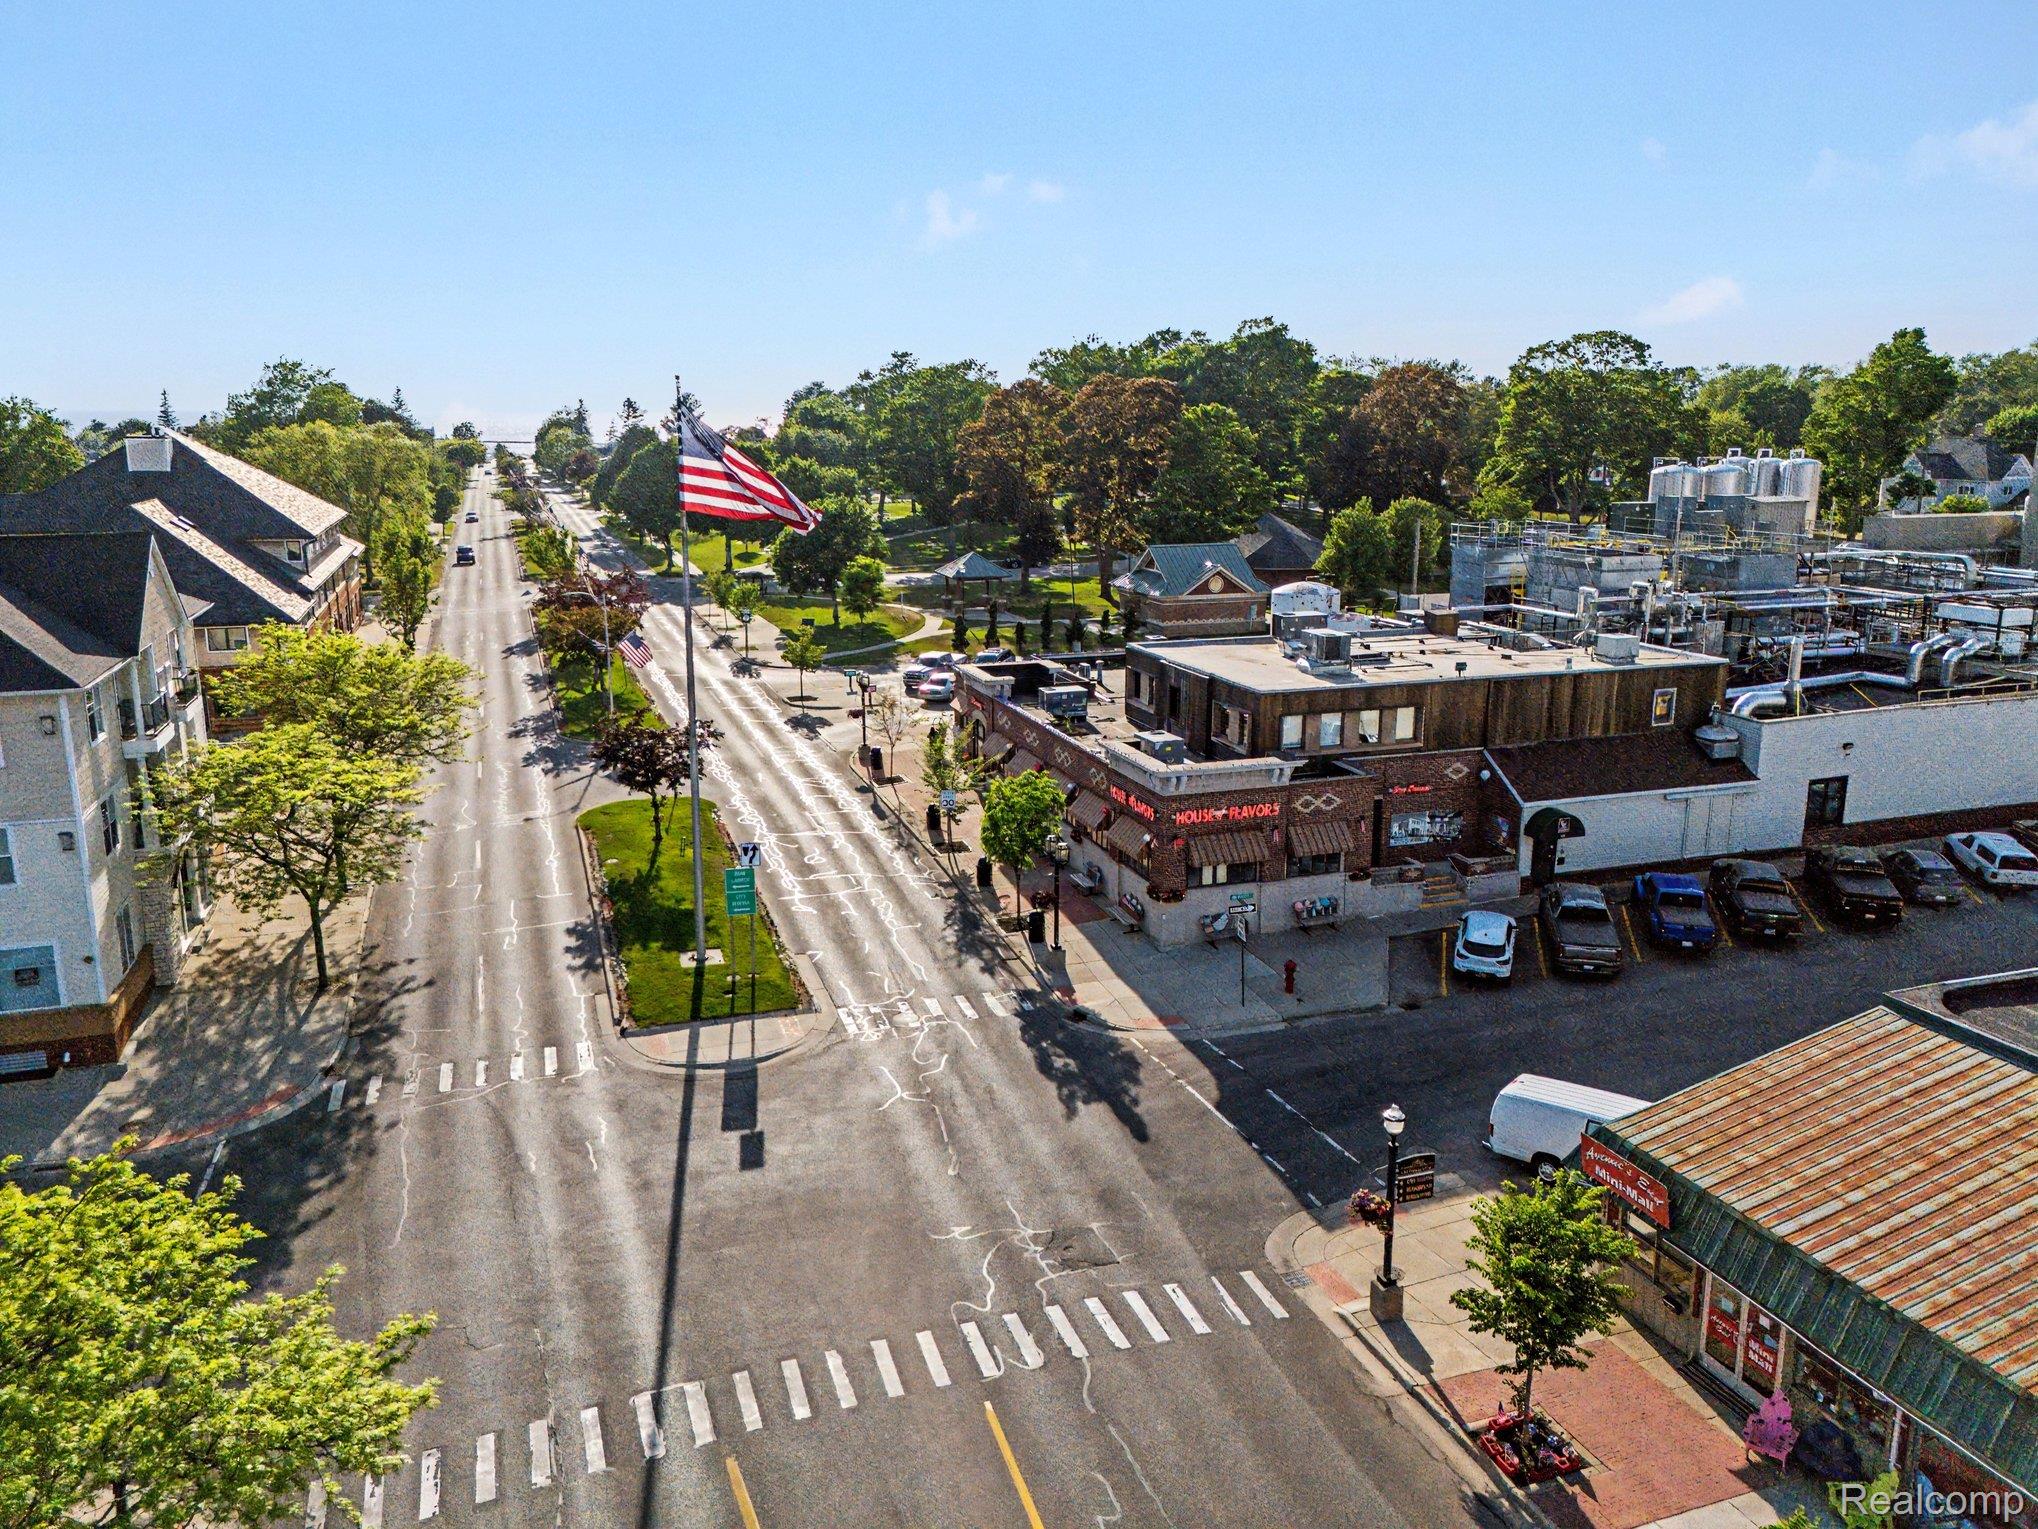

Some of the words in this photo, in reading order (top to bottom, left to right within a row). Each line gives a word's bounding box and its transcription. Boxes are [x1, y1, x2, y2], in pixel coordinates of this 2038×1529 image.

[1176, 808, 1214, 825] HOUSE
[1228, 802, 1280, 820] FLAVORS
[1595, 1165, 1654, 1212] Mini-Mall
